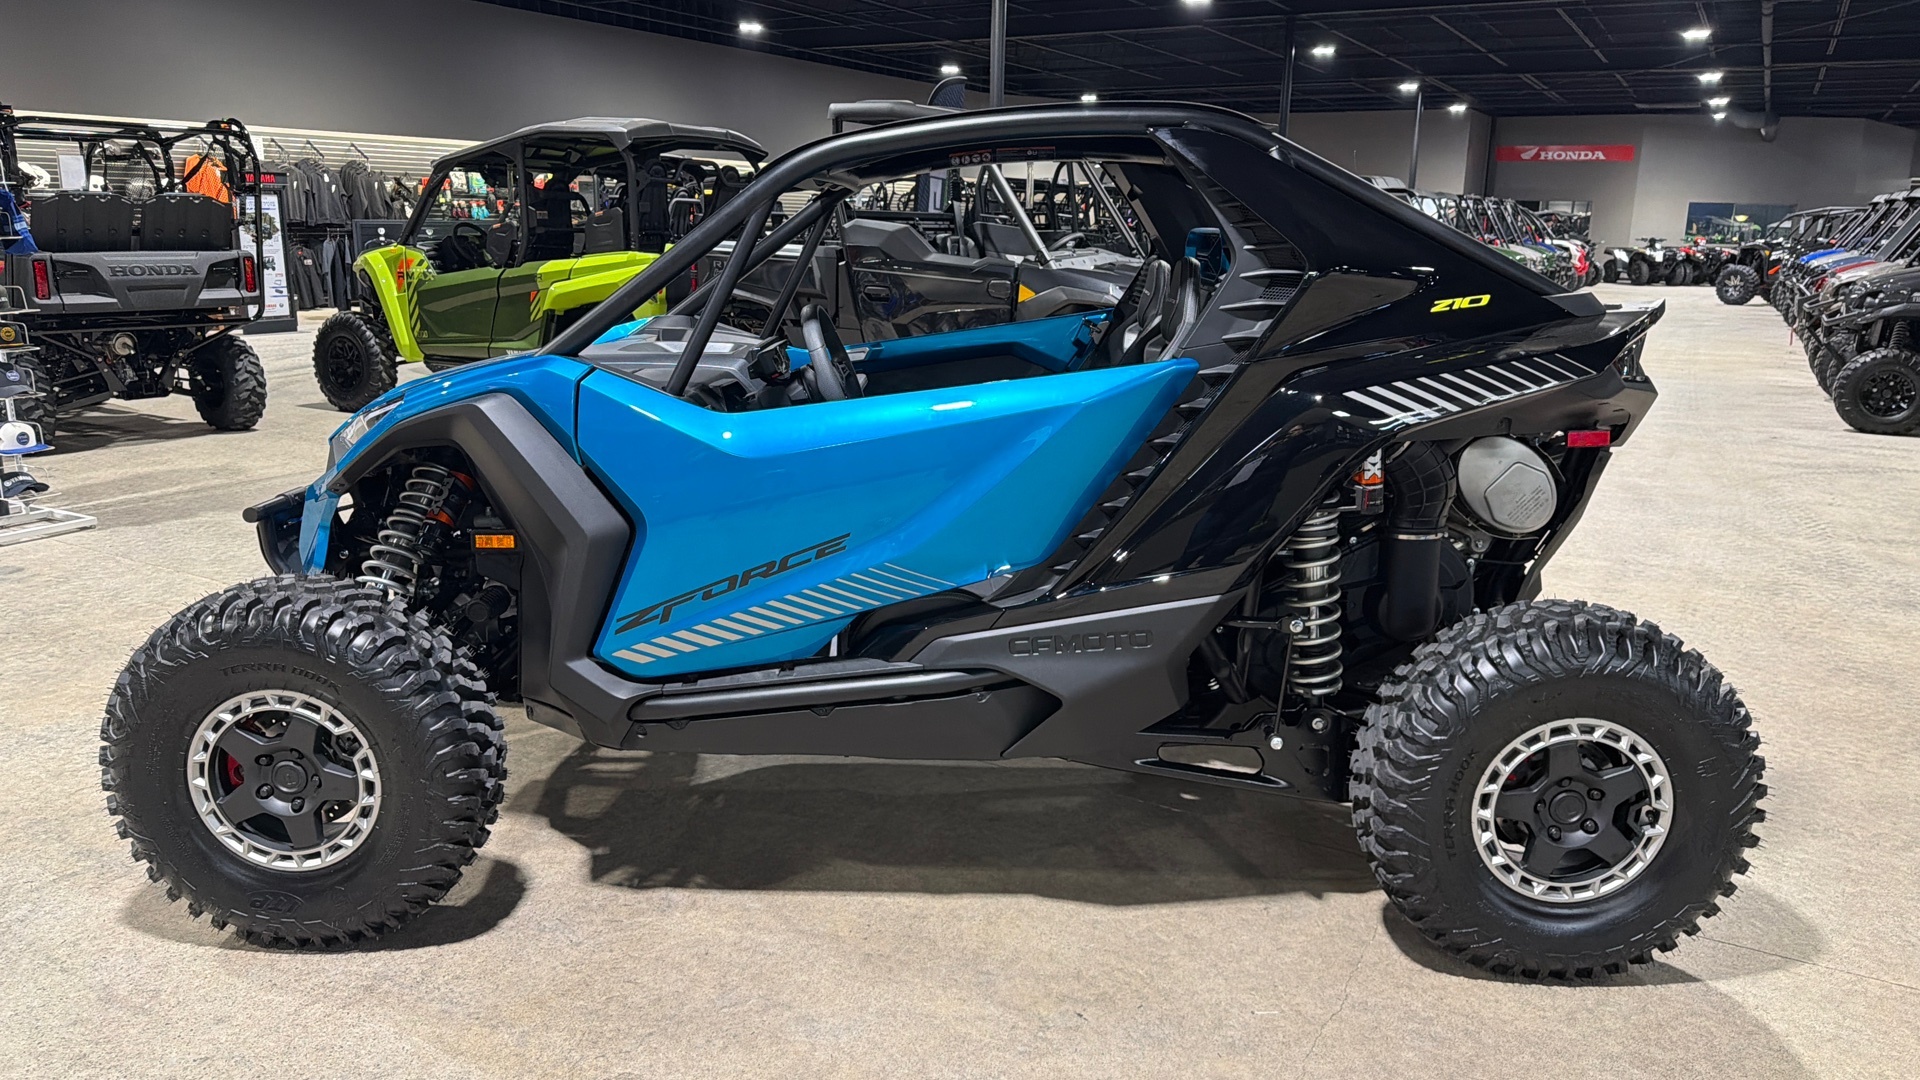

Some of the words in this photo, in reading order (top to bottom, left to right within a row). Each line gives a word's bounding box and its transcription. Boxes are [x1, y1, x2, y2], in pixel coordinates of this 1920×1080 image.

[1539, 150, 1606, 160] HONDA
[245, 173, 276, 183] YAAHA
[107, 264, 200, 277] HONDA
[1430, 294, 1491, 313] Z10
[615, 532, 851, 636] ZFORCE
[1008, 629, 1154, 657] CFMOTO
[219, 662, 287, 677] TERRA
[290, 665, 342, 695] HOOK
[1448, 748, 1480, 794] HOOK
